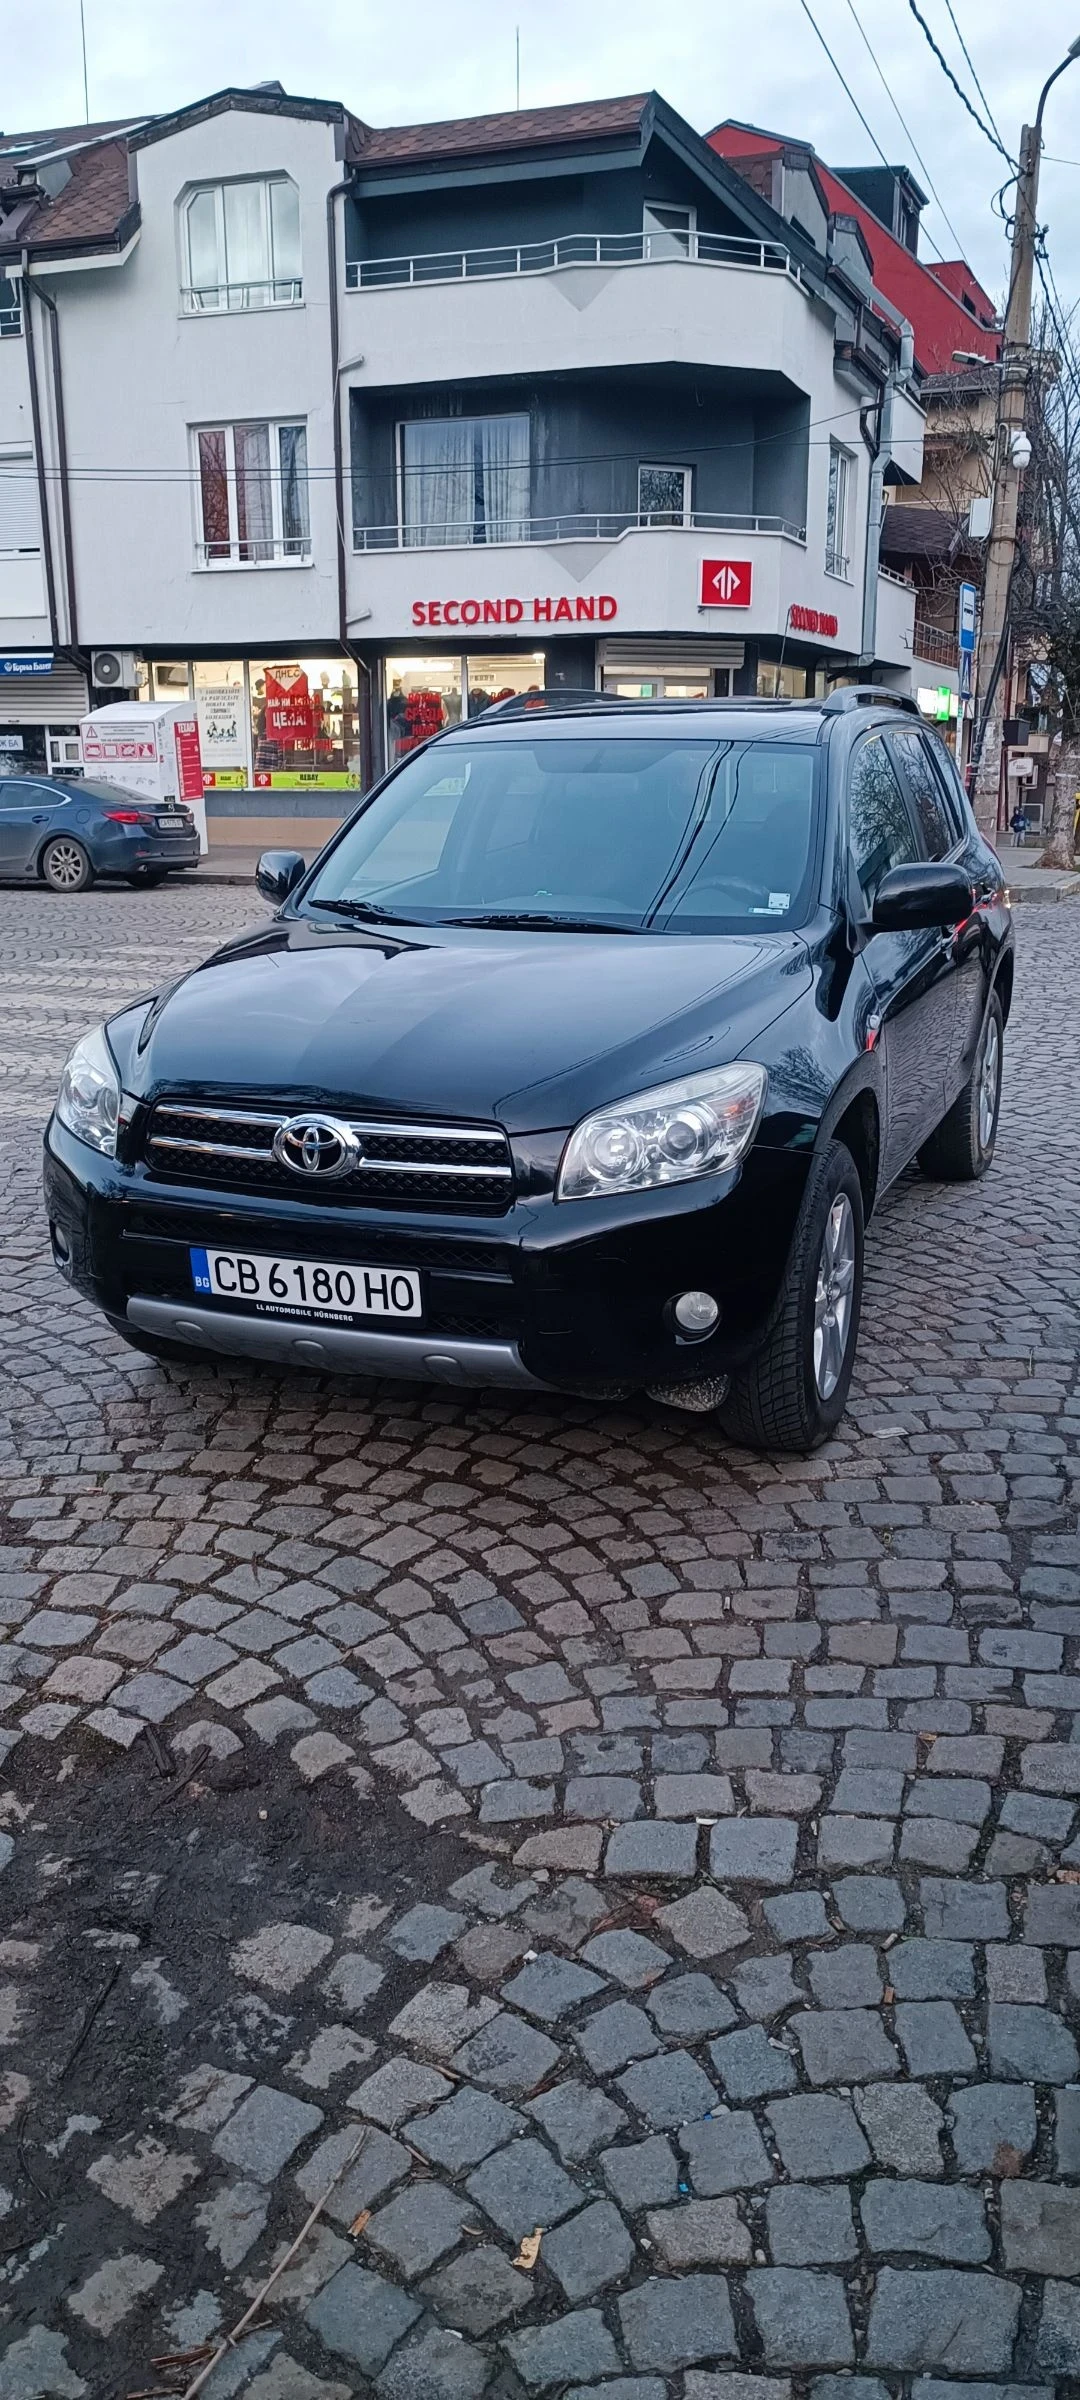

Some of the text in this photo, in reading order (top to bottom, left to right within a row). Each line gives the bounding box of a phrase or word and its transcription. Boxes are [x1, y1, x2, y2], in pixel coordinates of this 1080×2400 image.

[412, 595, 618, 626] SECOND HAND
[275, 669, 300, 680] ДНЕС
[195, 1276, 210, 1288] BG
[214, 1256, 414, 1312] CB 6180 HO
[265, 1305, 312, 1317] AUTOMOBILE
[314, 1310, 354, 1322] NÜRNBERG
